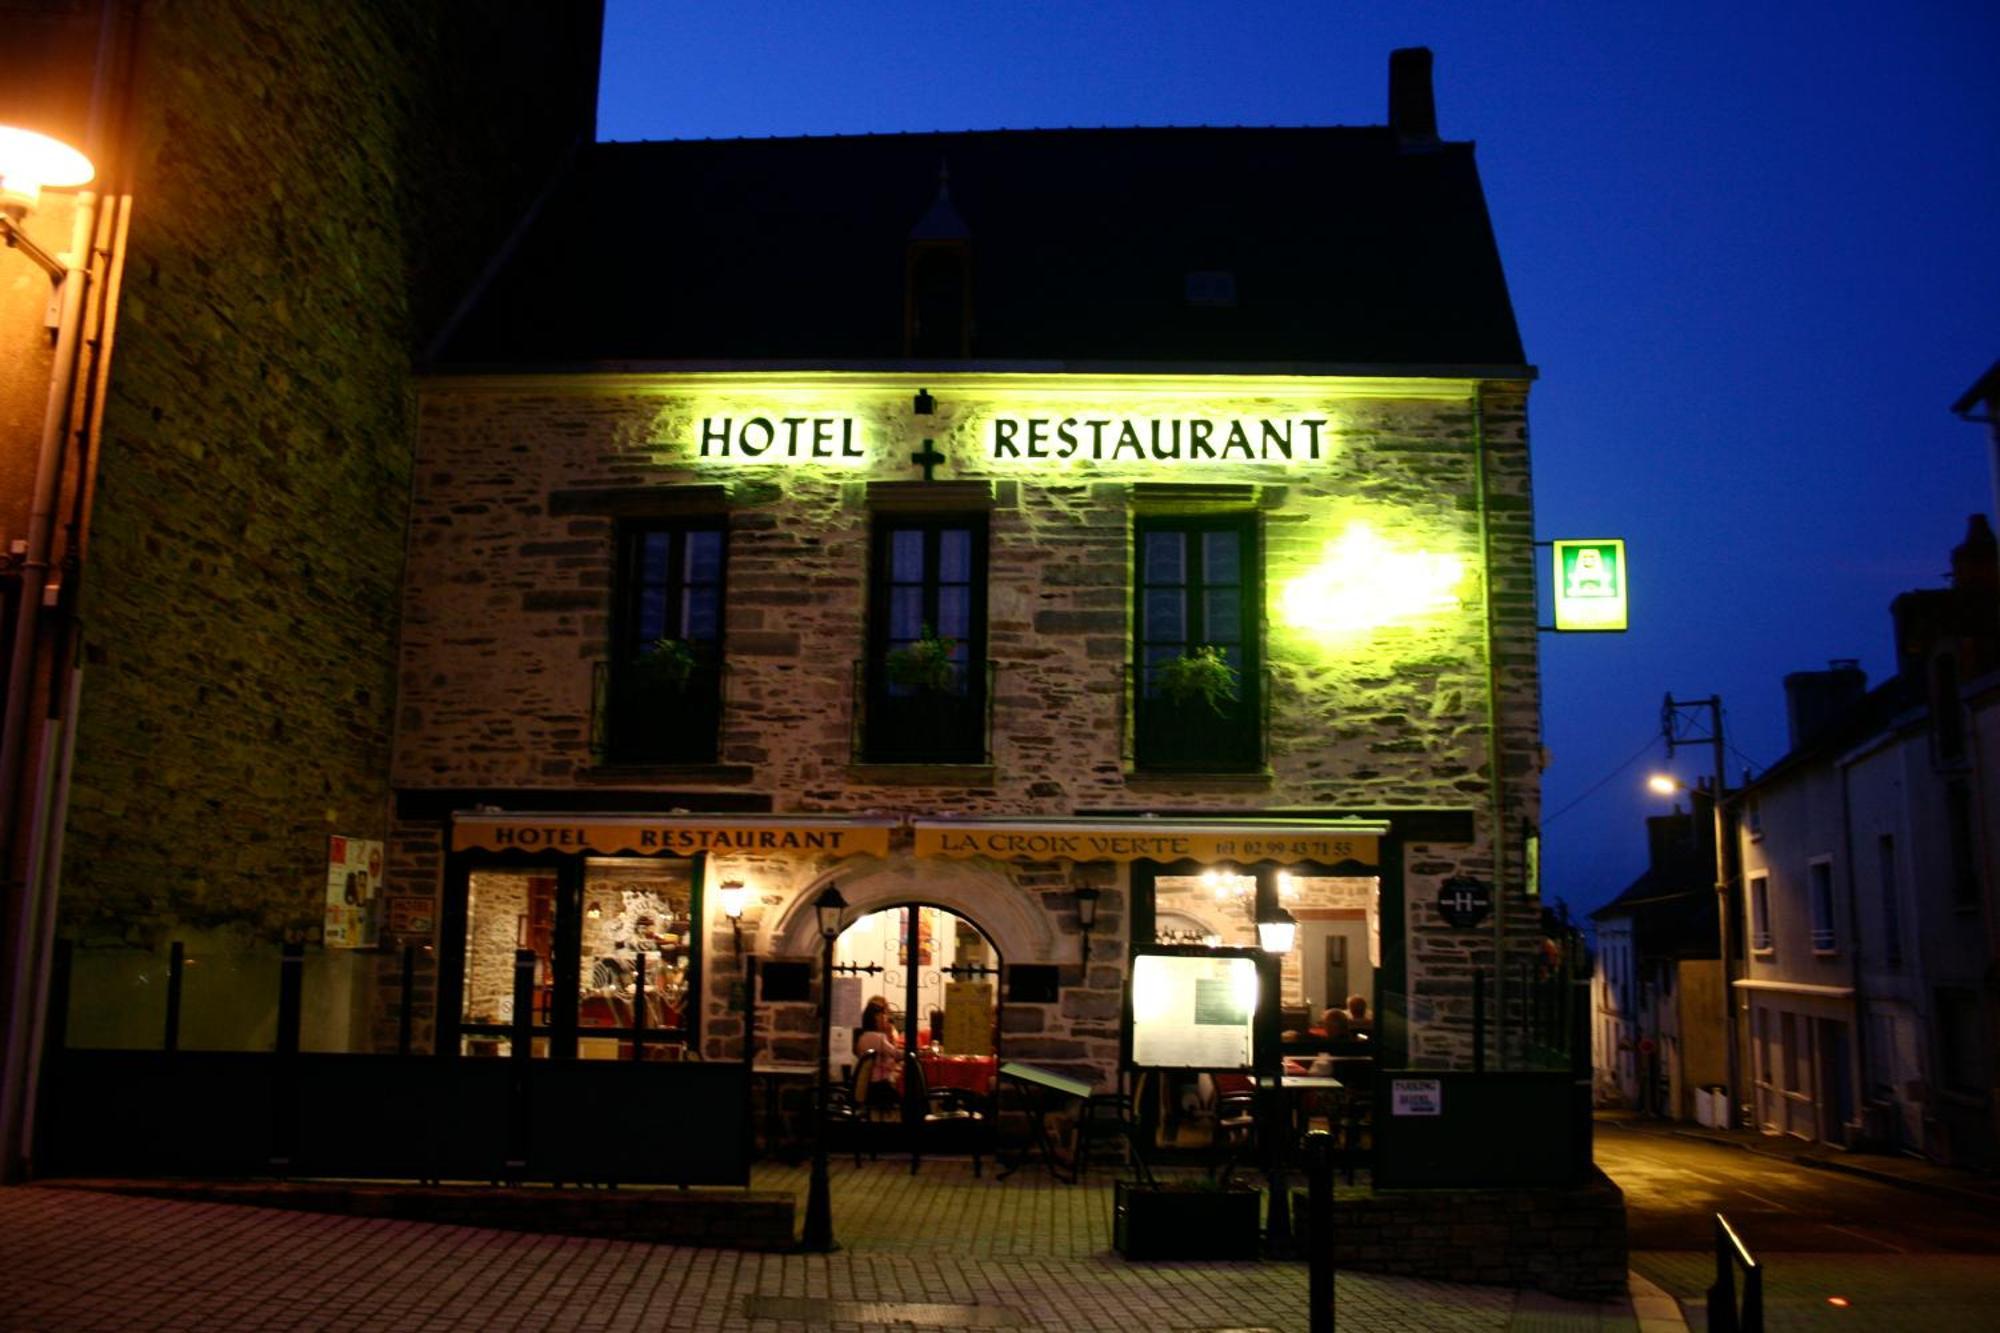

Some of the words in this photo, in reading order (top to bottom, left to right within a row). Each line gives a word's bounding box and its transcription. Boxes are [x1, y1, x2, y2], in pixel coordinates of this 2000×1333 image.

[700, 416, 864, 458] HOTEL
[994, 417, 1329, 460] RESTAURANT
[496, 826, 591, 847] HOTEL
[641, 828, 845, 849] RESTAURANT
[940, 833, 979, 852] LA
[987, 833, 1081, 855] CROIX
[1087, 836, 1191, 856] VERTE
[1243, 840, 1262, 856] 02
[1311, 841, 1329, 857] 71
[1455, 891, 1473, 912] H
